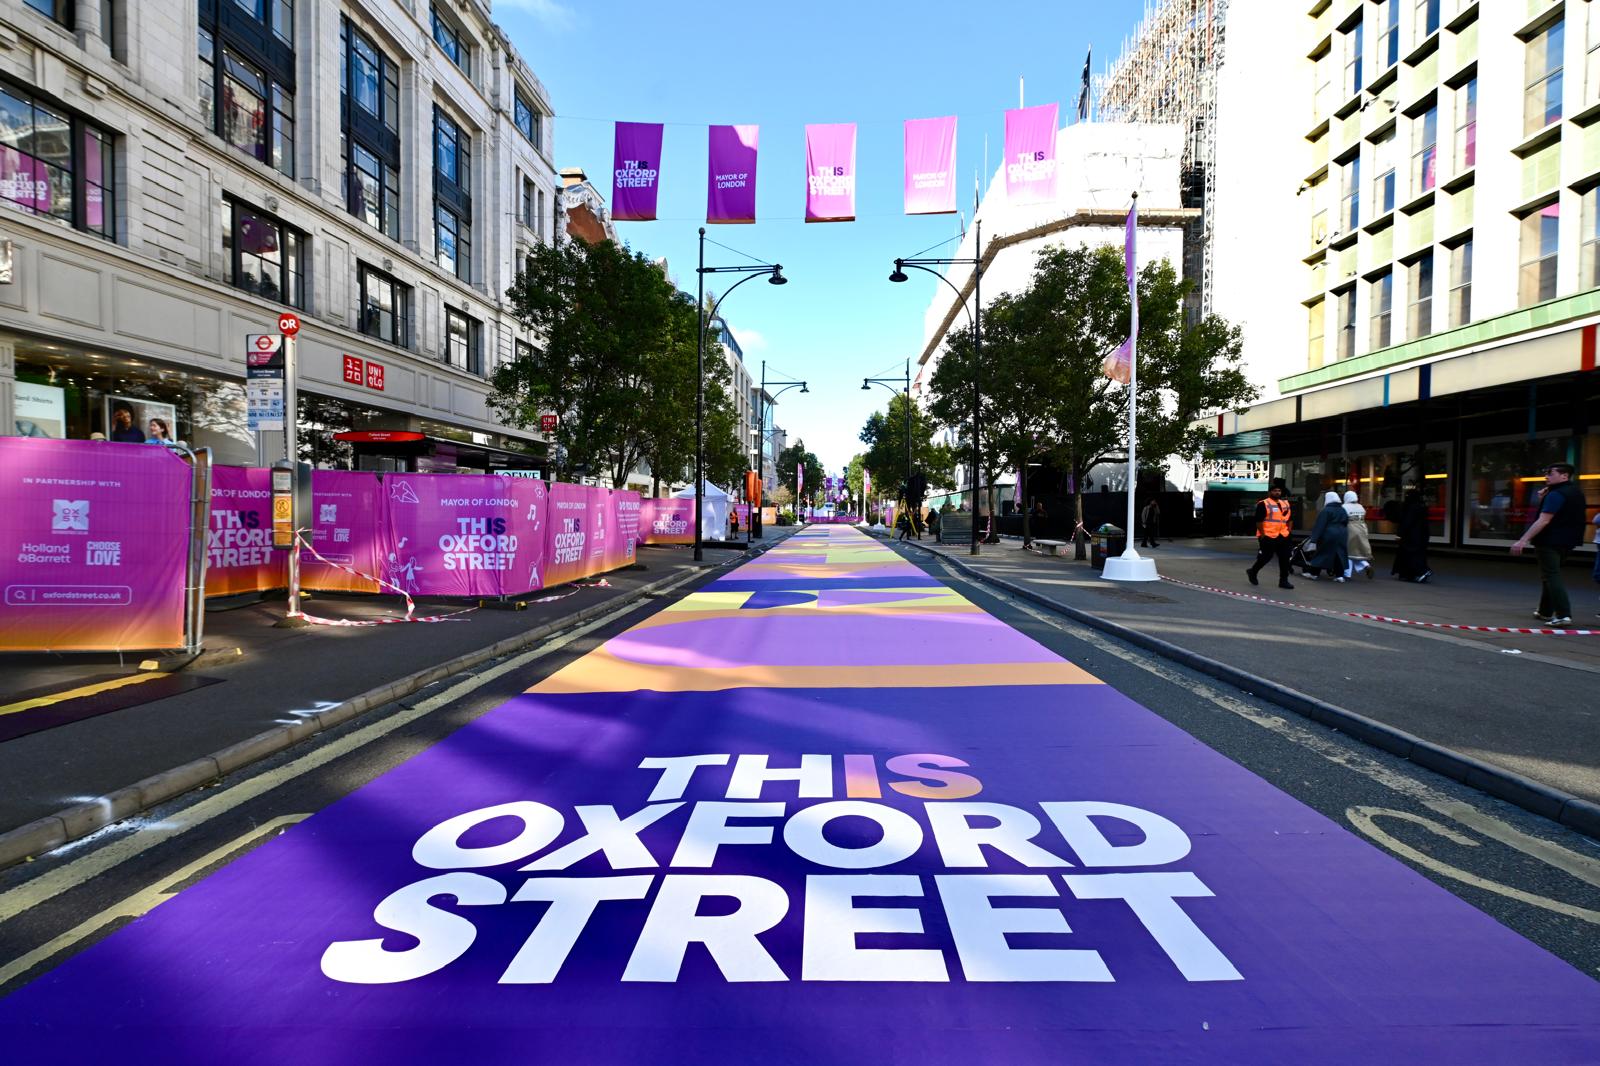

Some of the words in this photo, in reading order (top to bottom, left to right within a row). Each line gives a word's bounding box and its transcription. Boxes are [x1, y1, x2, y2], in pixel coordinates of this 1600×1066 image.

[624, 161, 648, 170] THIS
[615, 169, 657, 178] OXFORD
[616, 178, 655, 188] STREET
[717, 180, 746, 189] LONDON
[280, 319, 297, 329] OR
[368, 366, 382, 378] UNI
[368, 376, 383, 389] QLO
[35, 478, 96, 487] PARTNERSHIP
[99, 480, 121, 488] WITH
[441, 498, 470, 507] MAYOR
[485, 499, 519, 508] LONDON
[212, 510, 259, 529] THIS
[661, 513, 680, 521] THIS
[457, 517, 506, 535] THIS
[563, 518, 580, 533] THIS
[653, 520, 687, 528] OXFORD
[654, 527, 686, 535] STREET
[87, 541, 121, 551] CHOOSE
[439, 534, 518, 552] OXFORD
[555, 532, 585, 549] OXFORD
[22, 543, 70, 554] Holland
[86, 550, 121, 566] LOVE
[443, 552, 516, 570] STREET
[555, 546, 583, 565] STREET
[42, 591, 121, 600] oxfordstreet.co.uk
[638, 754, 983, 801] THIS
[412, 800, 1192, 871] OXFORD
[320, 871, 1246, 984] STREET
